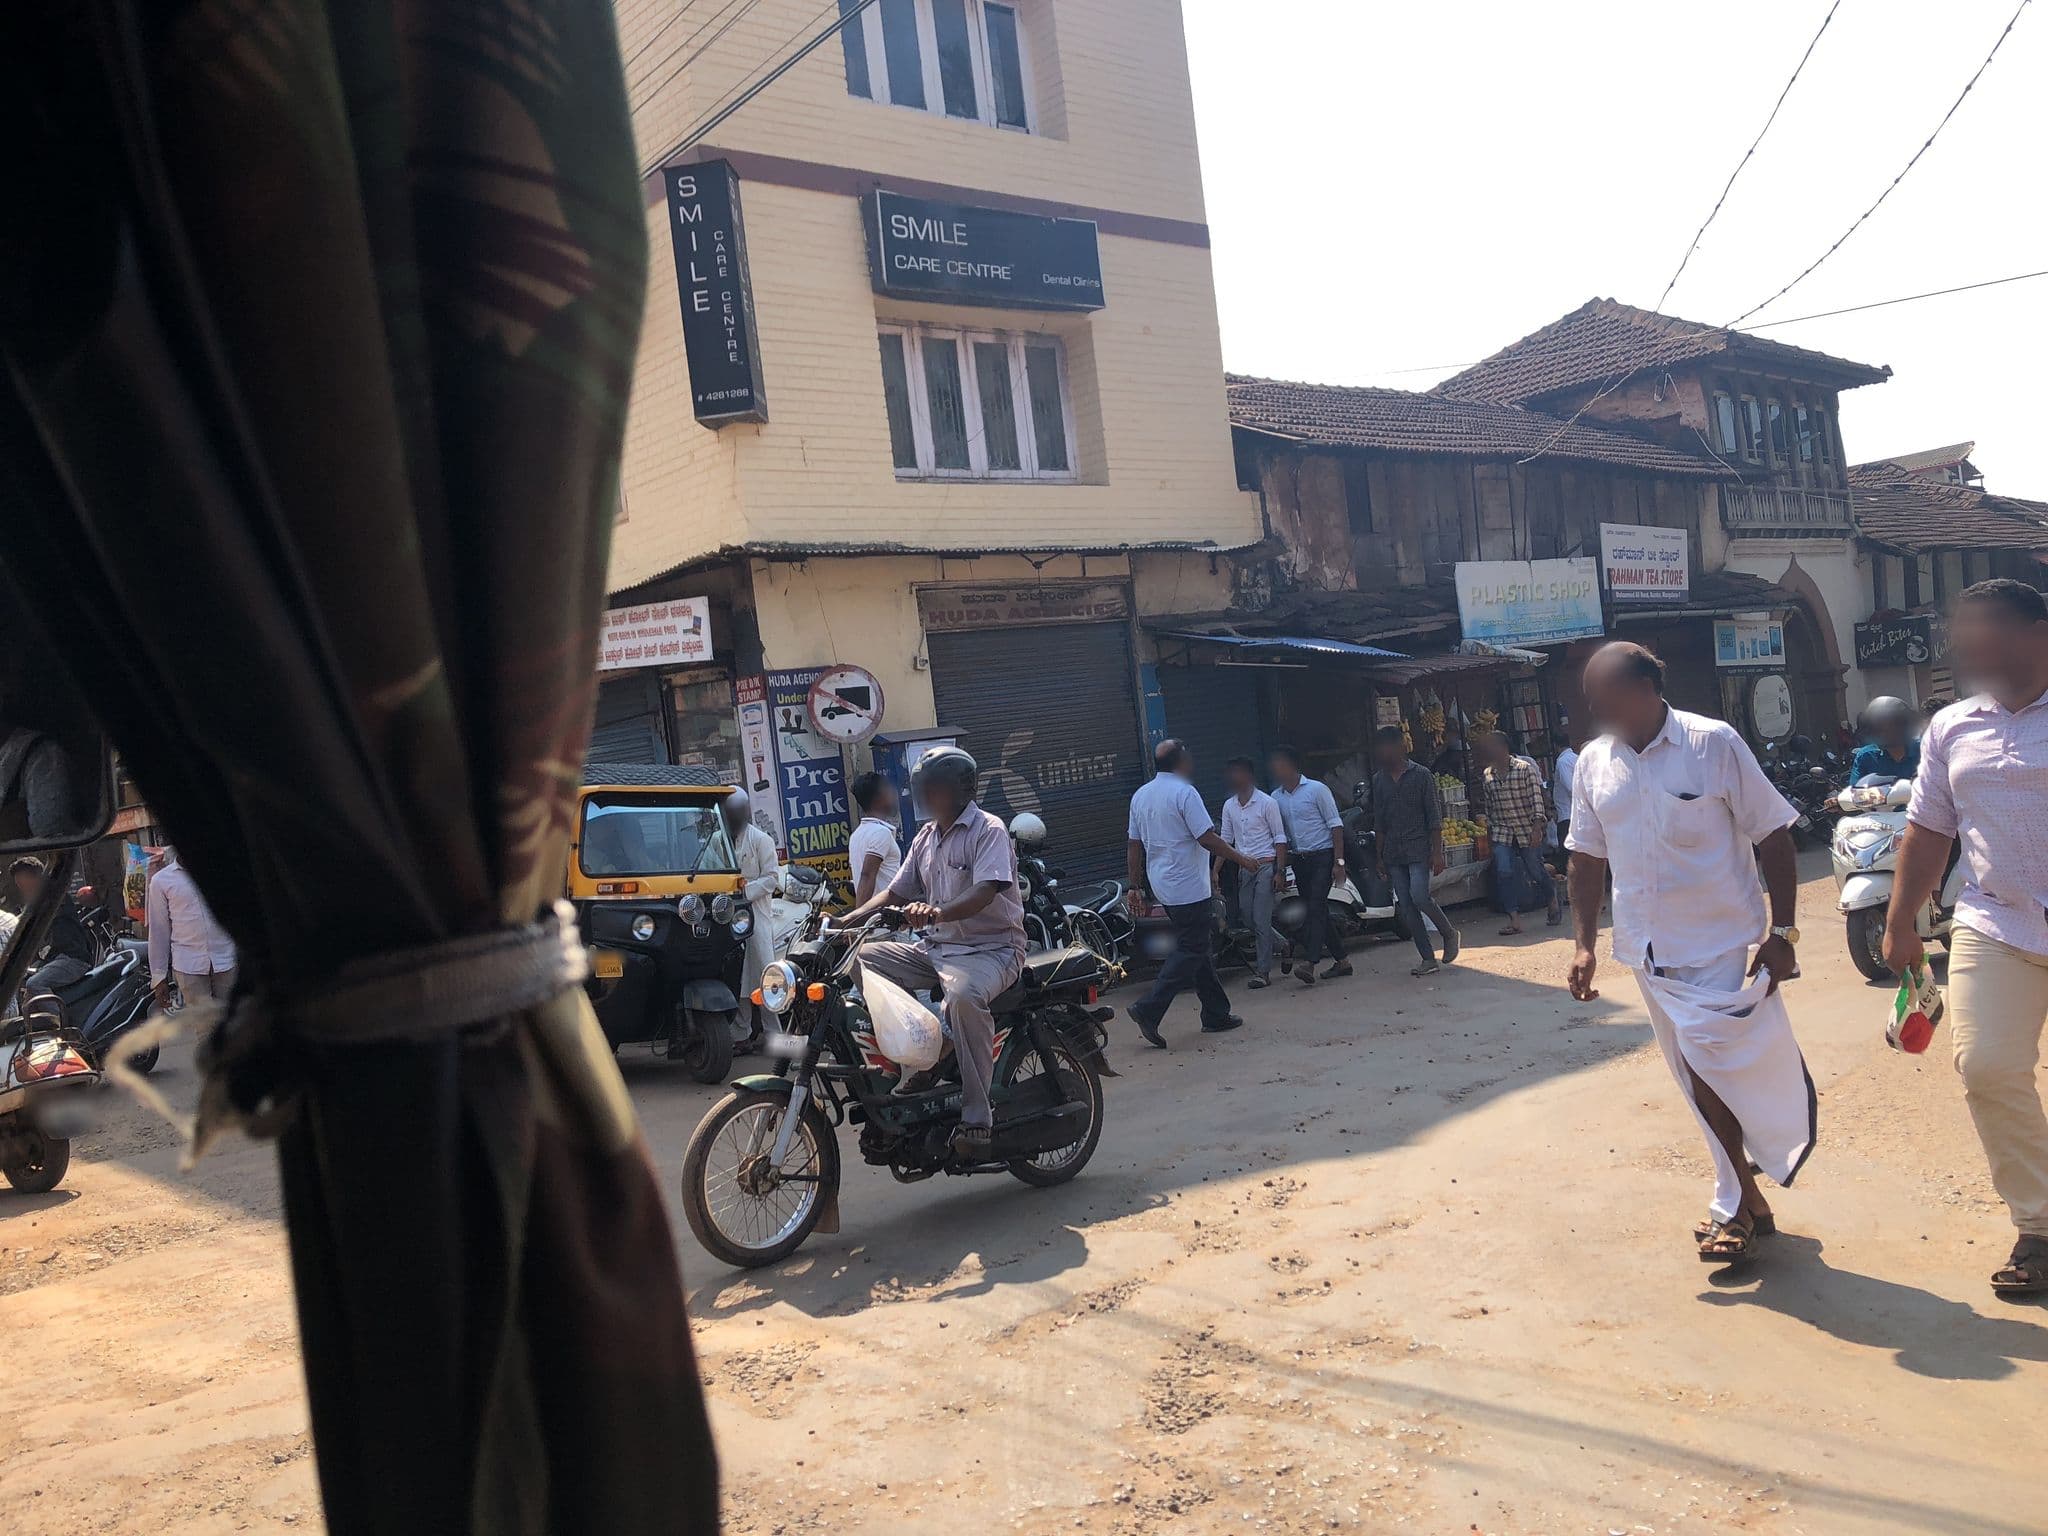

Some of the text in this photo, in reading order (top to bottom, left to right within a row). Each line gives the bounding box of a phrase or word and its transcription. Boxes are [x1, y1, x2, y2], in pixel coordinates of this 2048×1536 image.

[678, 175, 710, 312] SMILE
[891, 214, 968, 246] SMILE
[894, 254, 1012, 281] CARE CENTRE
[1042, 273, 1071, 286] Dental
[713, 230, 739, 362] CARE CENTRE
[1610, 568, 1684, 586] RAHMAN TEA STORE
[1471, 580, 1591, 607] PLASTIC SHOP
[928, 606, 1000, 625] HUDA
[768, 674, 791, 688] HUDA
[776, 693, 806, 704] Under
[785, 765, 840, 790] Pre
[786, 790, 847, 820] Ink
[790, 820, 850, 855] STAMPS
